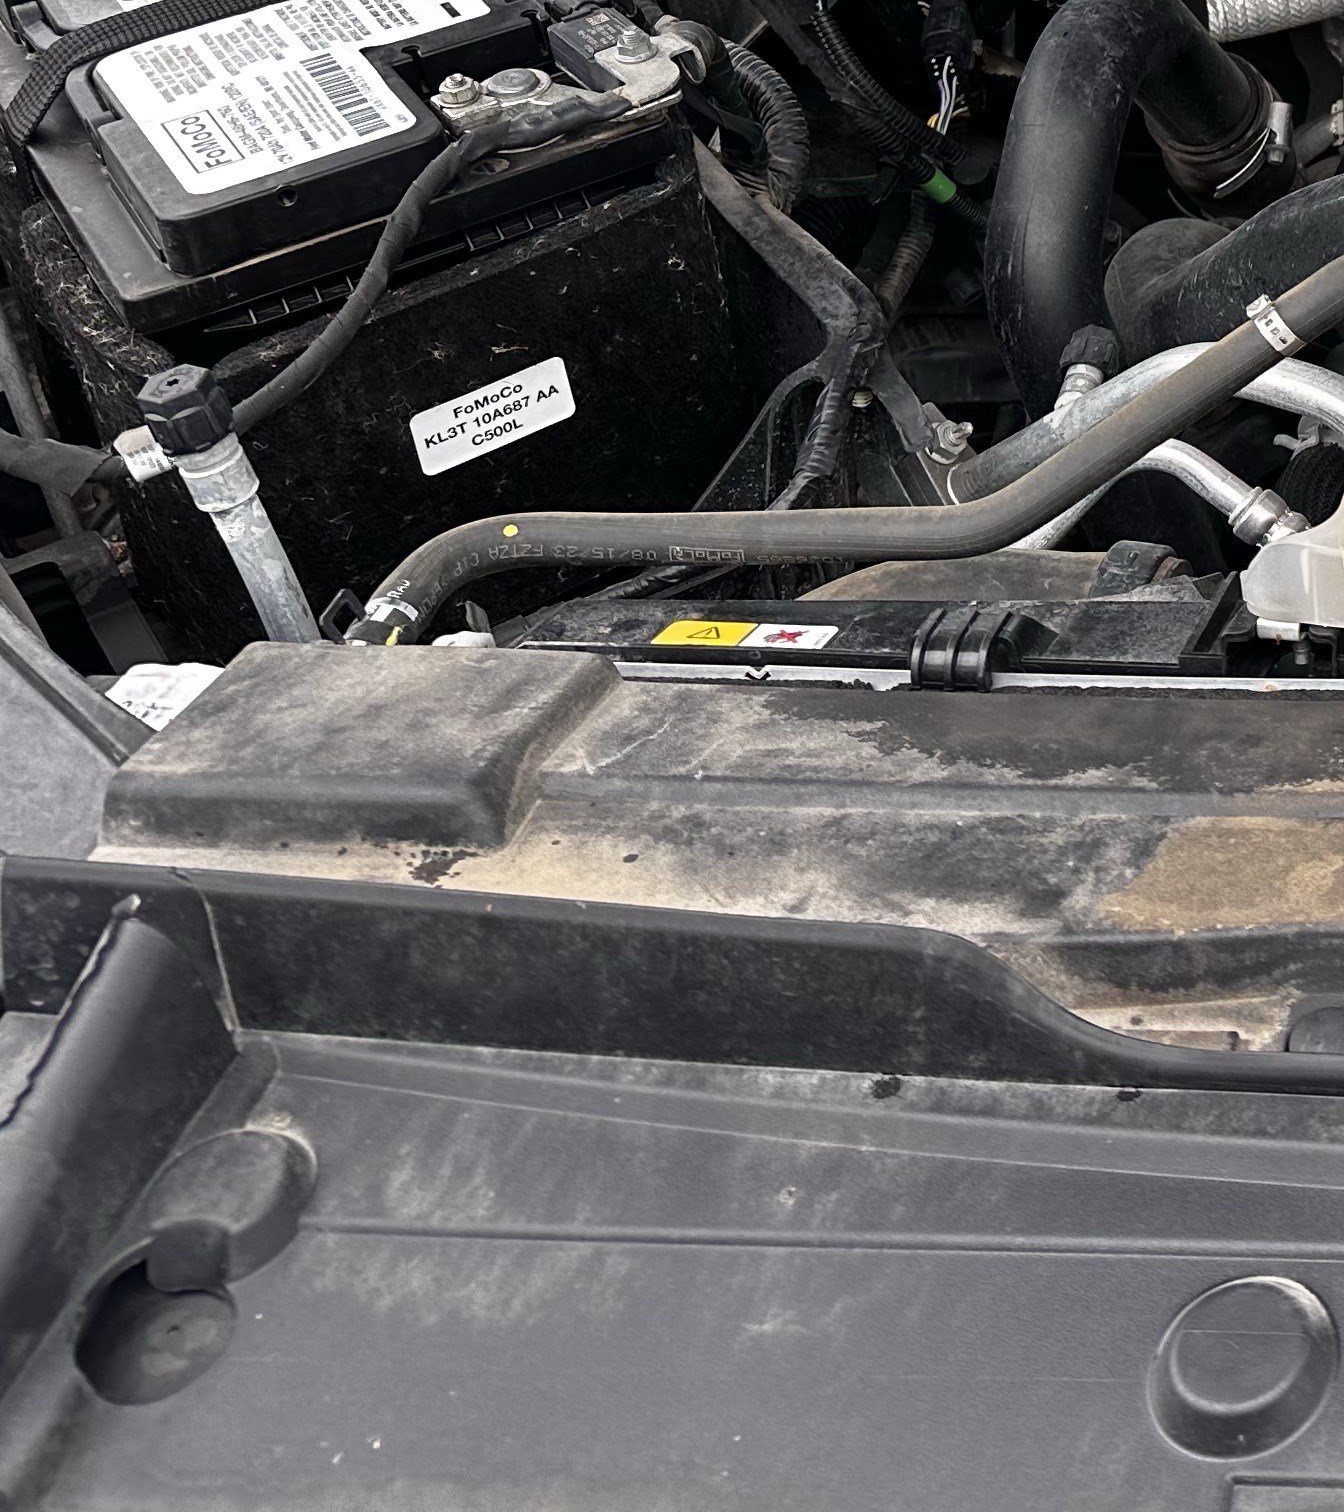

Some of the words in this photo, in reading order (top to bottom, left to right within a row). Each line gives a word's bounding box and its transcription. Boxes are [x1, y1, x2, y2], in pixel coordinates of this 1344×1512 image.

[172, 115, 233, 167] FoMoCo
[424, 421, 468, 449] KL3T
[473, 395, 531, 428] 10A687
[536, 385, 560, 403] AA
[453, 384, 523, 419] FoMoCo
[471, 419, 524, 446] C500L
